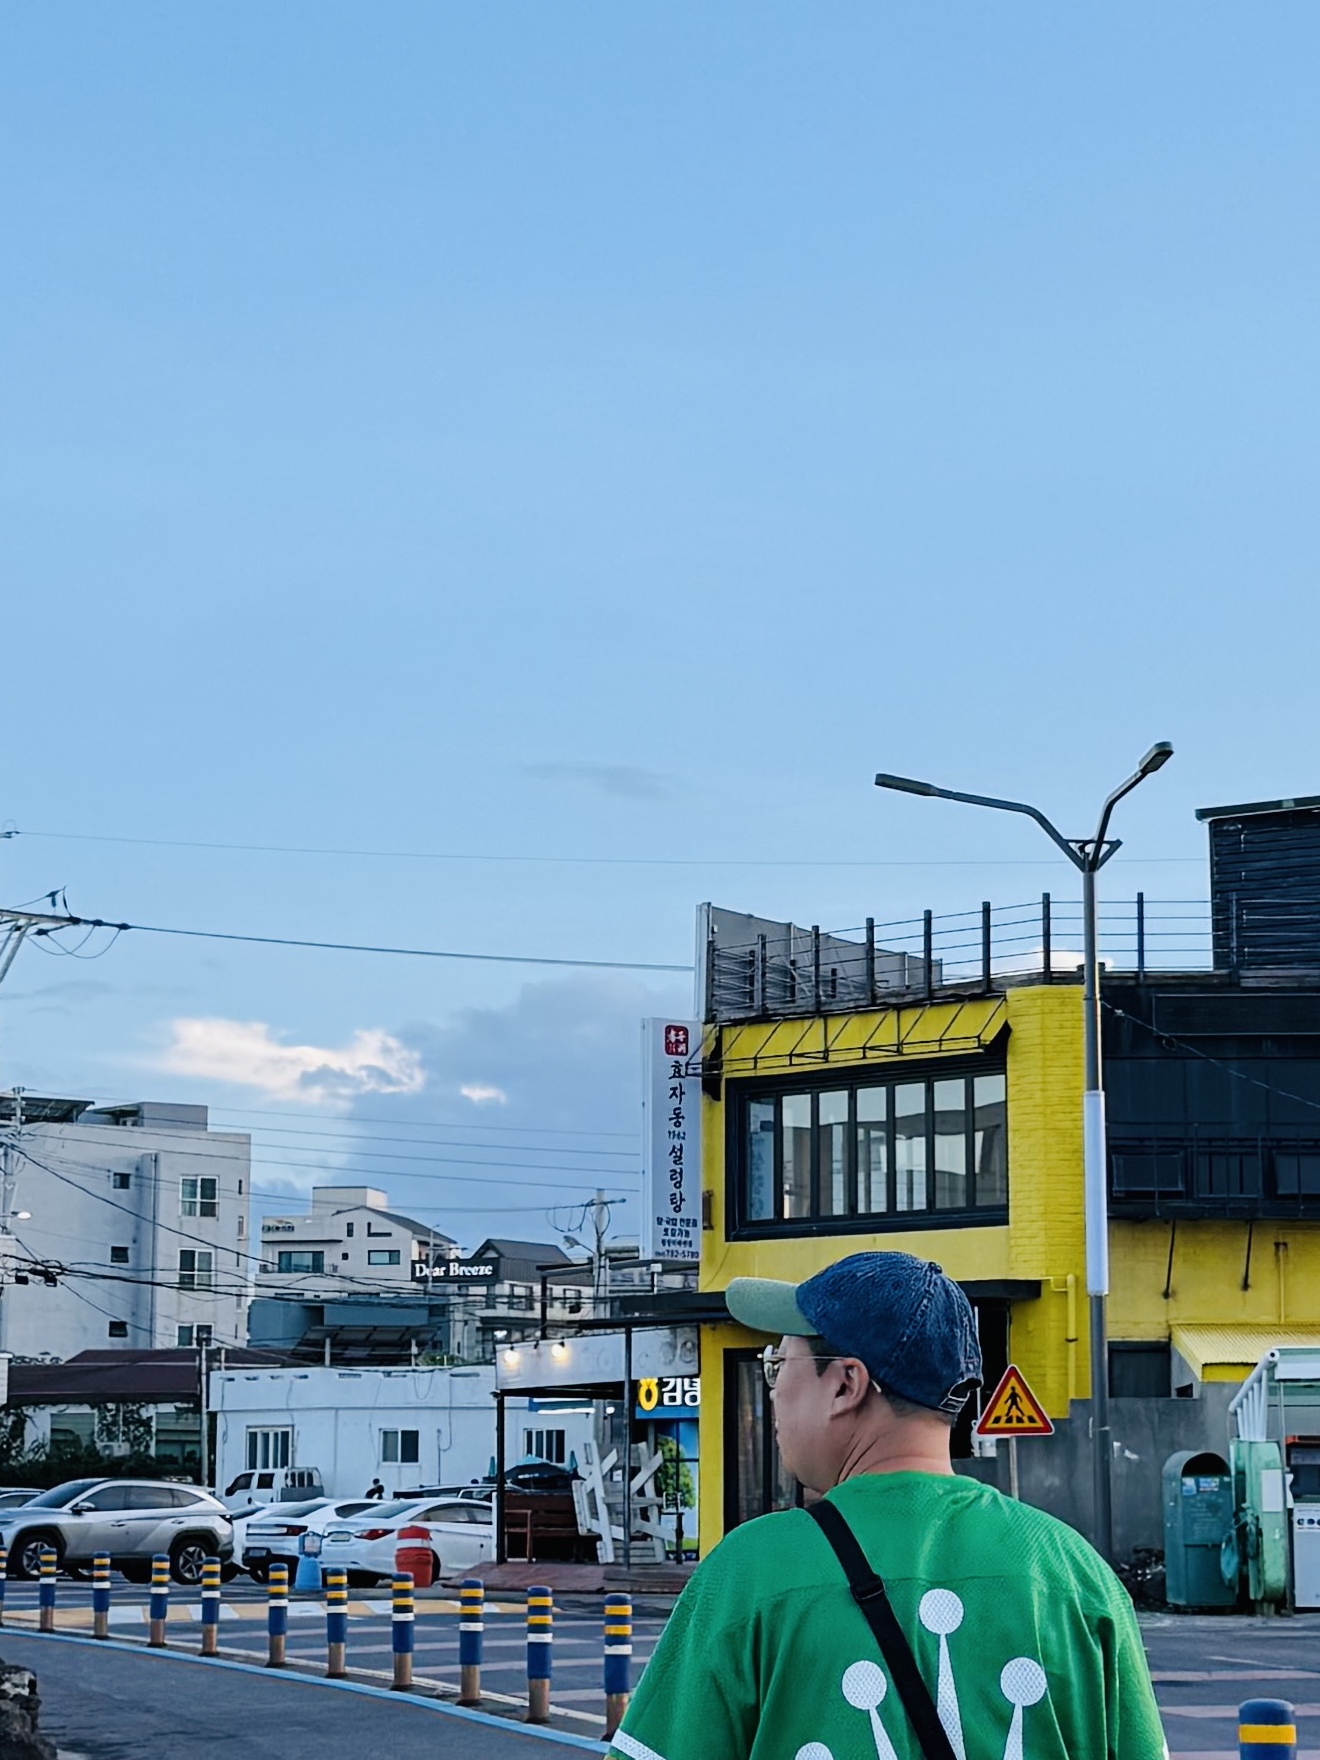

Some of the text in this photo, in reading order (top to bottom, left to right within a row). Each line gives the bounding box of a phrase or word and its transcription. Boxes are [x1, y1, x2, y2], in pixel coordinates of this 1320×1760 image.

[668, 1060, 686, 1128] 효자동
[668, 1143, 686, 1213] 설렁탕
[449, 1262, 493, 1276] Breeze
[661, 1377, 701, 1407] 김녕
